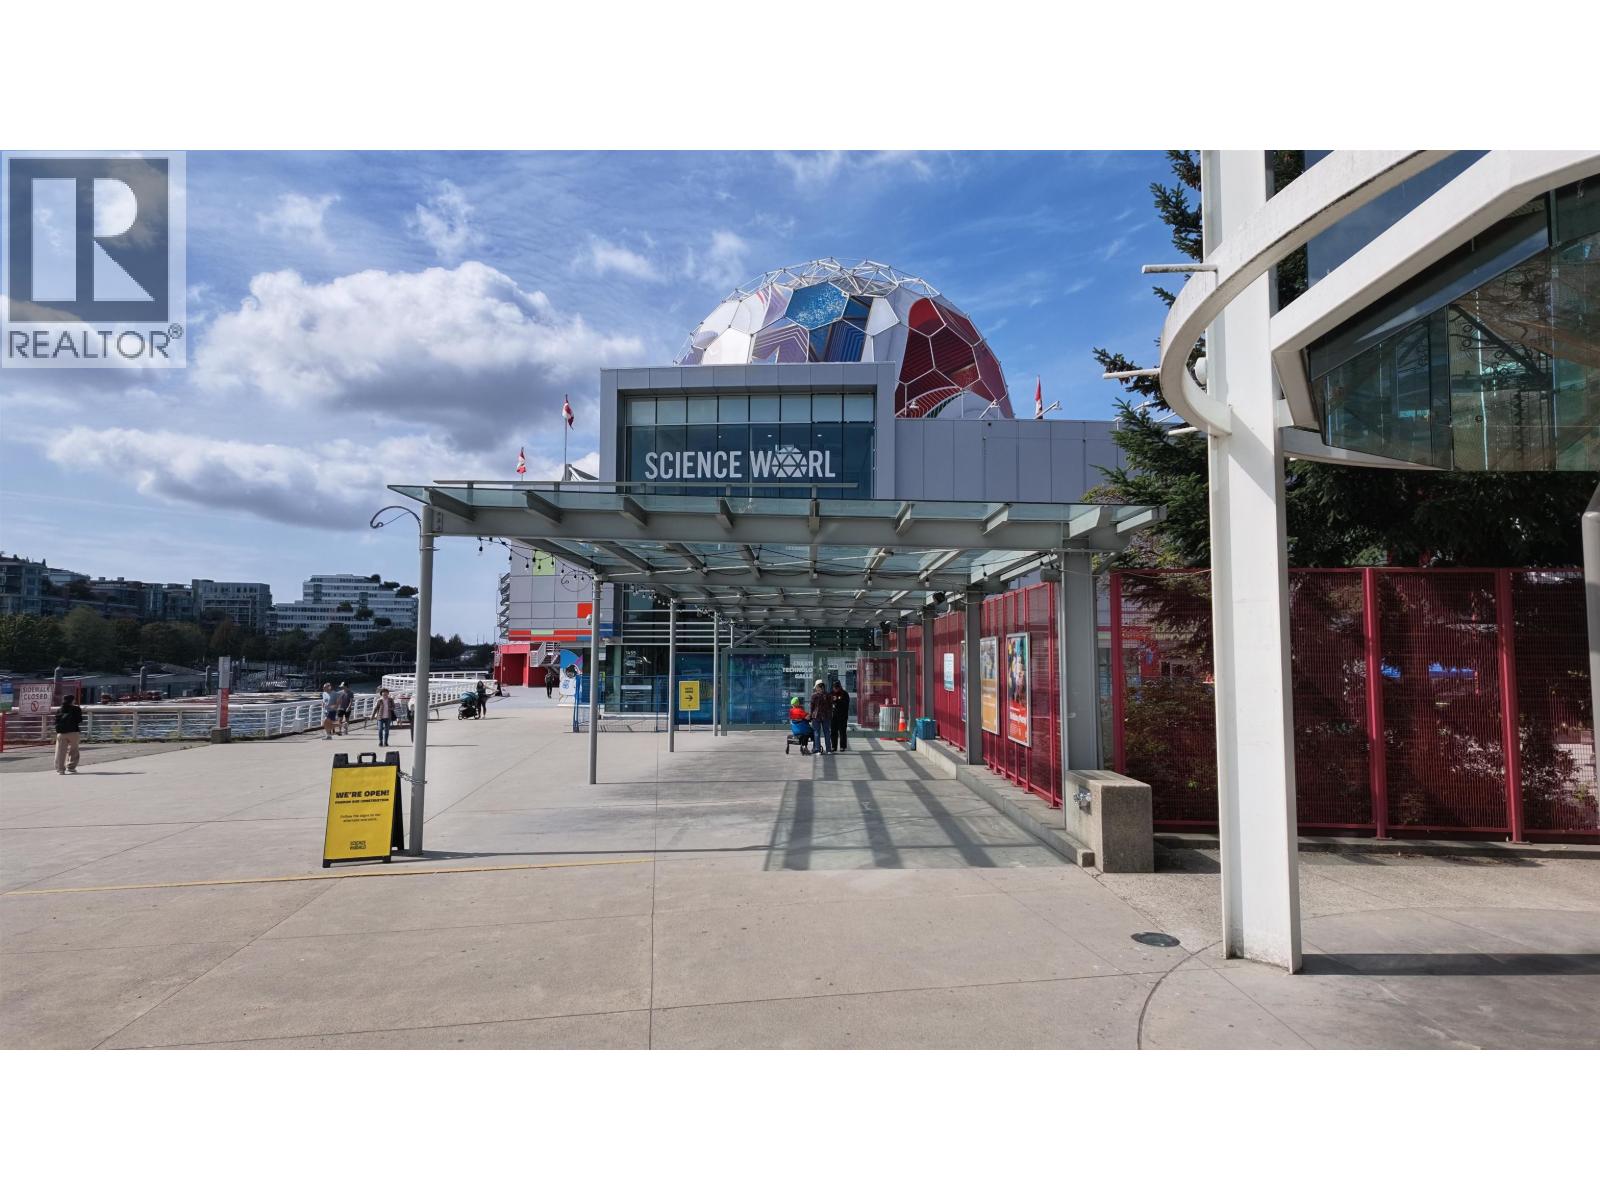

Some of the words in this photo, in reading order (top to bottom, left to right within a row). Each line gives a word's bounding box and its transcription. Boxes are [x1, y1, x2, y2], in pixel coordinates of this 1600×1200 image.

[645, 451, 742, 479] SCIENCE
[335, 791, 362, 799] WE'RE
[364, 789, 390, 797] OPEN!
